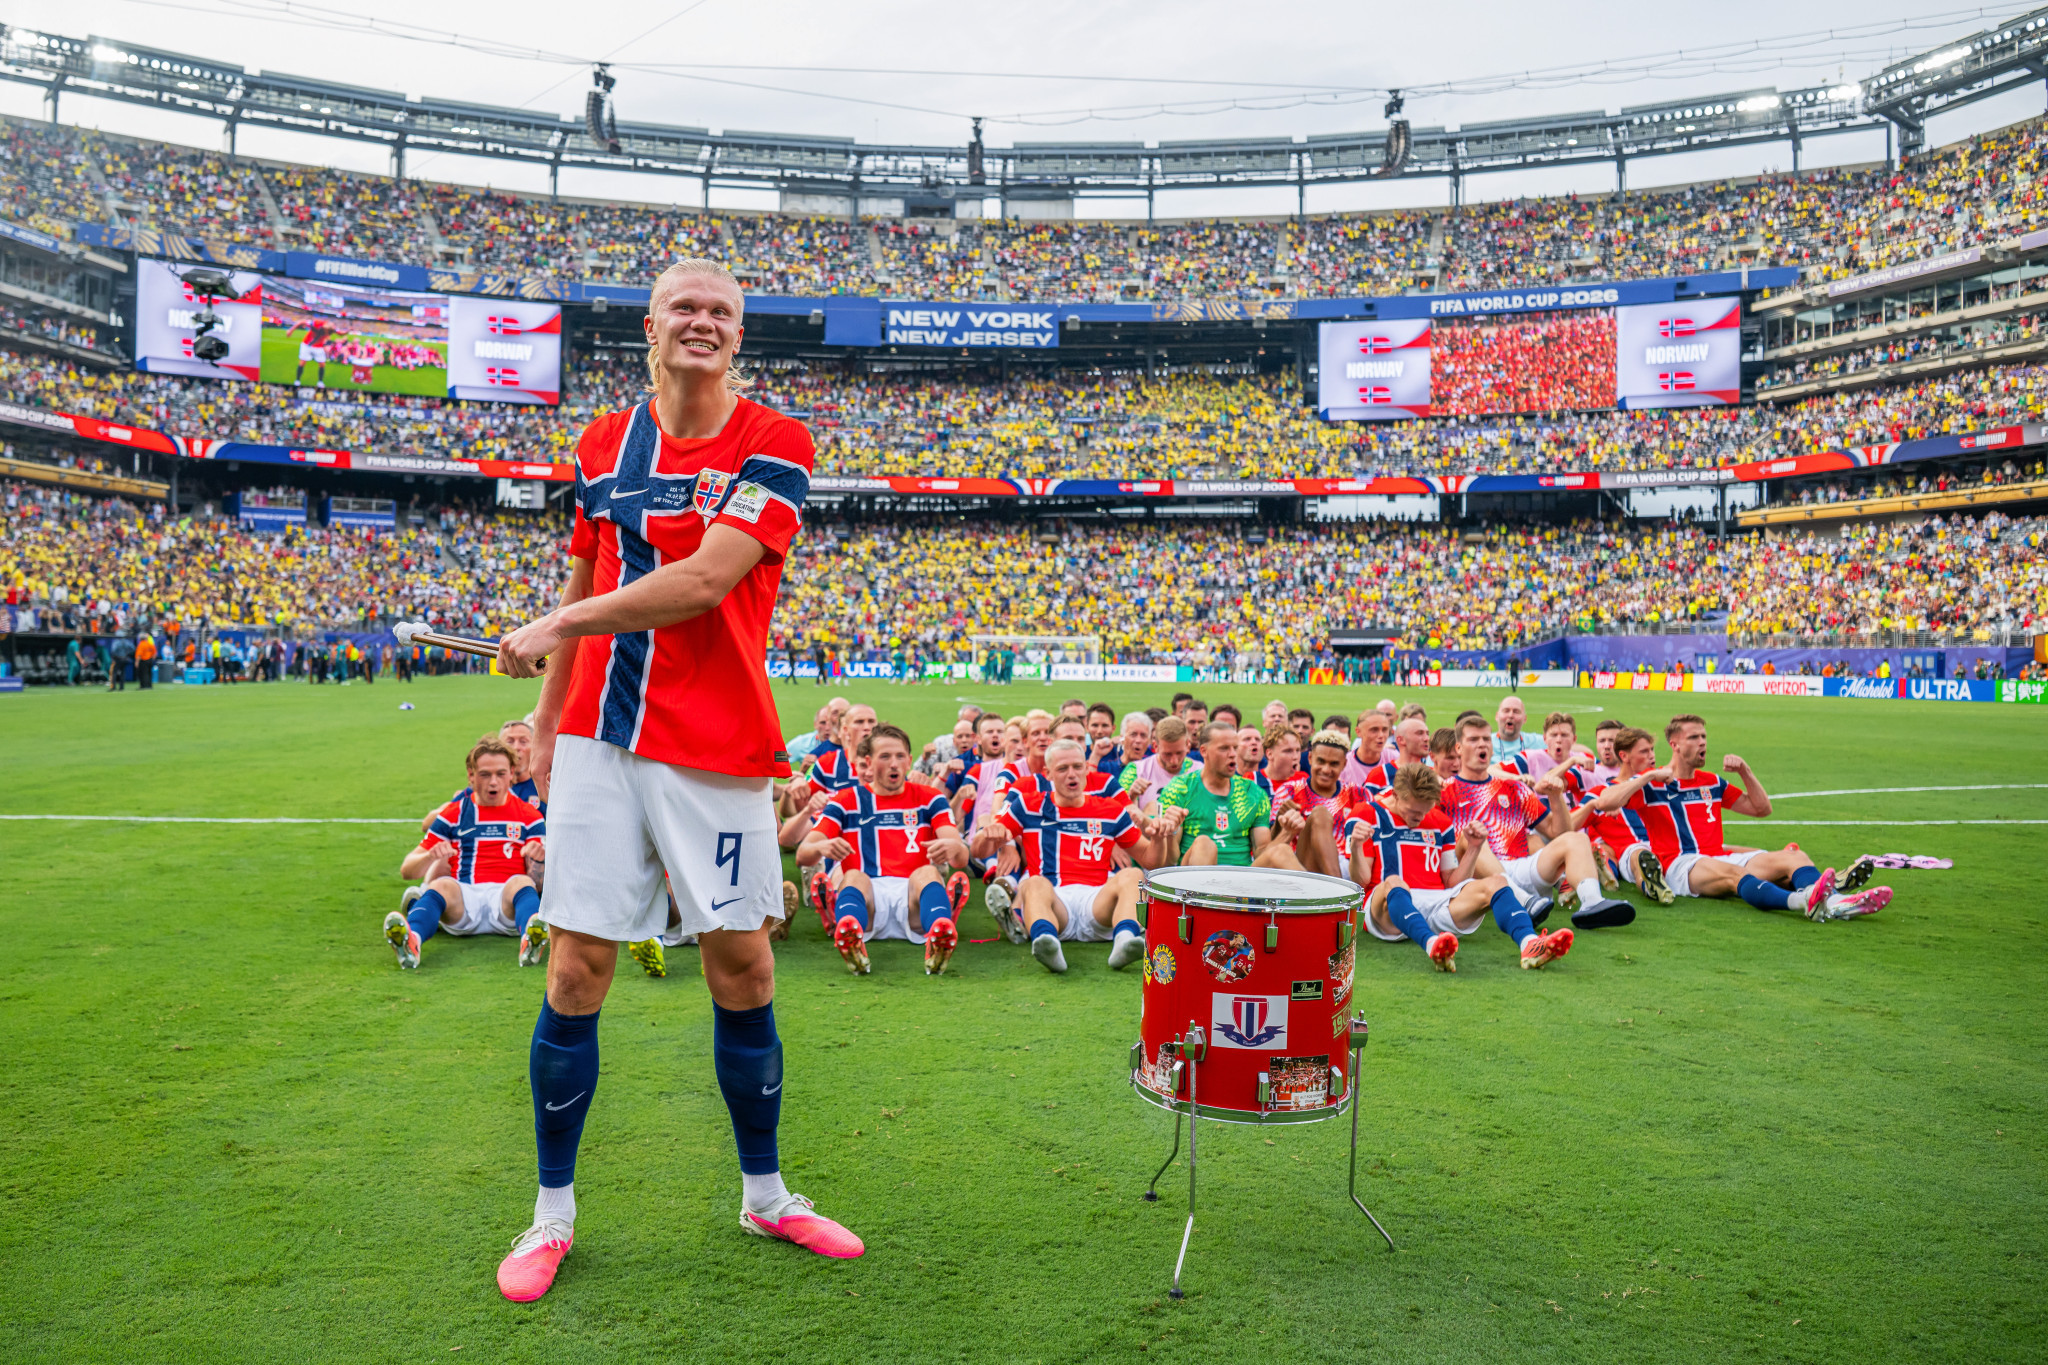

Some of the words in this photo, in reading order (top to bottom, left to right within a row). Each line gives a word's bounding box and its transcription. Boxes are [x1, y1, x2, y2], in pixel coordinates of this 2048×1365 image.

[315, 259, 399, 284] #FIFAWorldCup
[1834, 278, 1860, 293] NEW
[1860, 271, 1893, 287] YORK
[1894, 263, 1921, 279] NEW
[1923, 251, 1973, 272] JERSEY
[1430, 299, 1465, 315] FIFA
[1466, 295, 1524, 312] WORLD
[1526, 292, 1559, 308] CUP
[1560, 289, 1619, 306] 2026
[889, 310, 961, 327] NEW
[966, 311, 1053, 329] YORK
[889, 330, 948, 344] NEW
[952, 331, 1053, 346] JERSEY
[474, 340, 533, 361] NORWAY
[1645, 343, 1709, 365] NORWAY
[1346, 360, 1404, 379] NORWAY
[1976, 431, 2007, 448] NORWAY
[366, 455, 389, 468] FIFA
[389, 457, 425, 470] WORLD
[425, 458, 445, 471] CUP
[445, 458, 479, 472] 2026
[1188, 482, 1210, 493] FIFA
[1210, 482, 1242, 493] WORLD
[1242, 482, 1262, 493] CUP
[1262, 482, 1295, 493] 2026
[1554, 475, 1585, 488] NORWAY
[1616, 474, 1638, 485] FIFA
[1638, 472, 1677, 484] WORLD
[1677, 471, 1699, 483] CUP
[730, 500, 756, 514] EDUCATION
[1706, 674, 1745, 693] verizon
[1764, 675, 1807, 695] verizon
[1840, 677, 1894, 698] Michelob
[1911, 679, 1972, 700] ULTRA
[503, 841, 514, 859] 6
[904, 829, 920, 853] 8
[1079, 836, 1104, 861] 26
[715, 832, 743, 886] 9
[1423, 846, 1440, 873] 10
